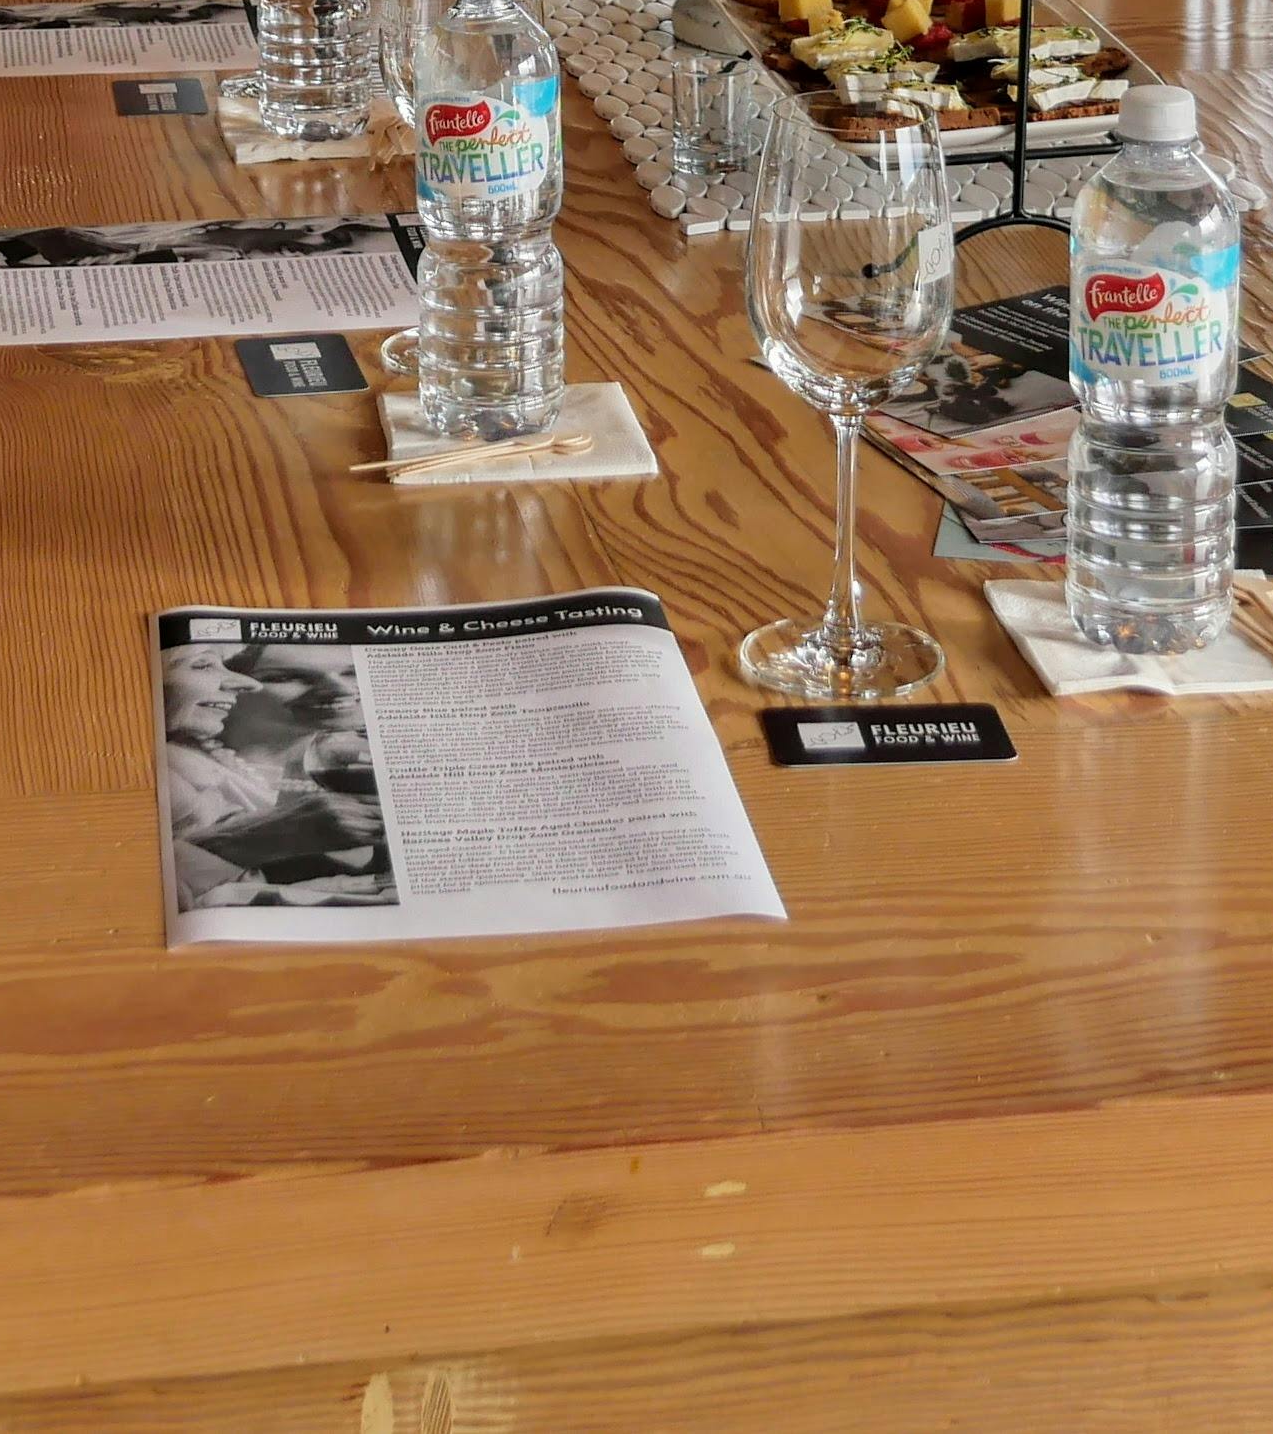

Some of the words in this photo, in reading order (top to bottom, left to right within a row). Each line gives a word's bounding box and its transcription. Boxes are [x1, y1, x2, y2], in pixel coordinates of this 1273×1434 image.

[420, 143, 544, 184] TRAVELLER
[1104, 317, 1121, 330] THE
[1121, 299, 1209, 334] perfect
[1078, 319, 1223, 366] TRAVELLER
[250, 622, 338, 632] FLEURIEU
[367, 623, 429, 636] Wine
[439, 622, 455, 634] &
[463, 614, 549, 632] Cheese
[555, 605, 643, 622] Tasting
[251, 631, 287, 639] FOOD
[307, 631, 338, 639] WINE
[870, 722, 977, 737] FLEURIEU
[874, 734, 920, 745] FOOD
[925, 734, 936, 744] &
[941, 733, 981, 743] WINE
